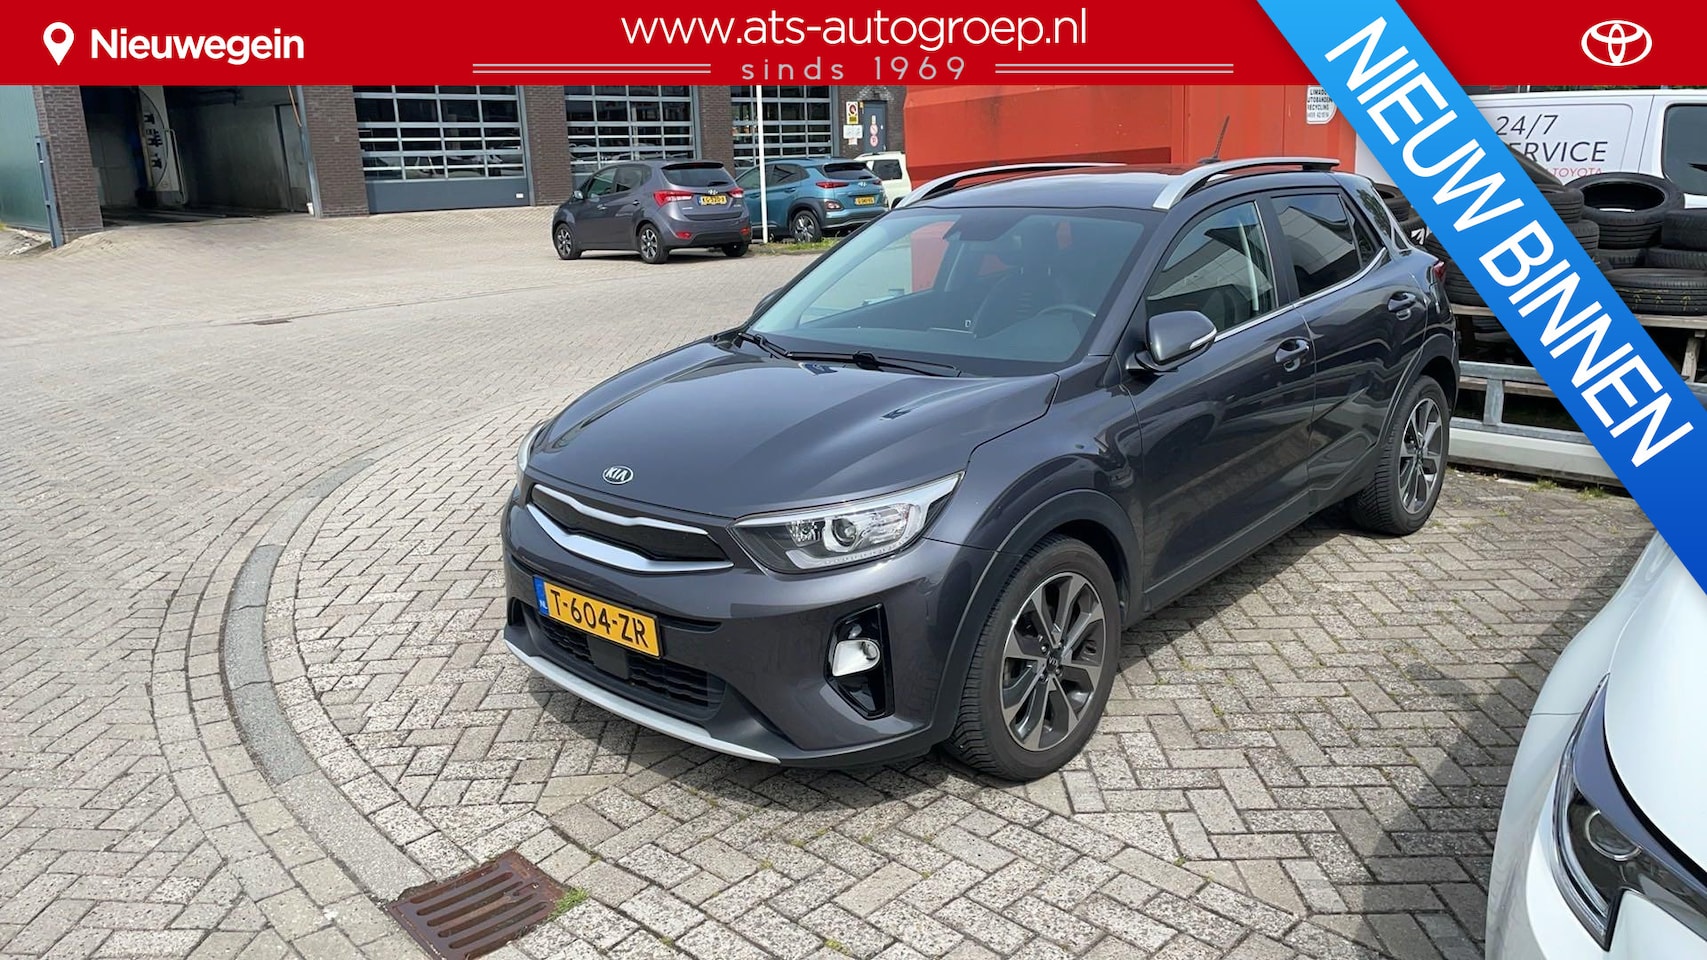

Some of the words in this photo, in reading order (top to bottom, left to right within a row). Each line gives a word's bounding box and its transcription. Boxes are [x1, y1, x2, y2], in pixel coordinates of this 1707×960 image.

[1496, 114, 1559, 139] 24/7
[1508, 141, 1608, 162] RVICE
[605, 467, 629, 481] KIA
[550, 589, 649, 649] T-604-ZR
